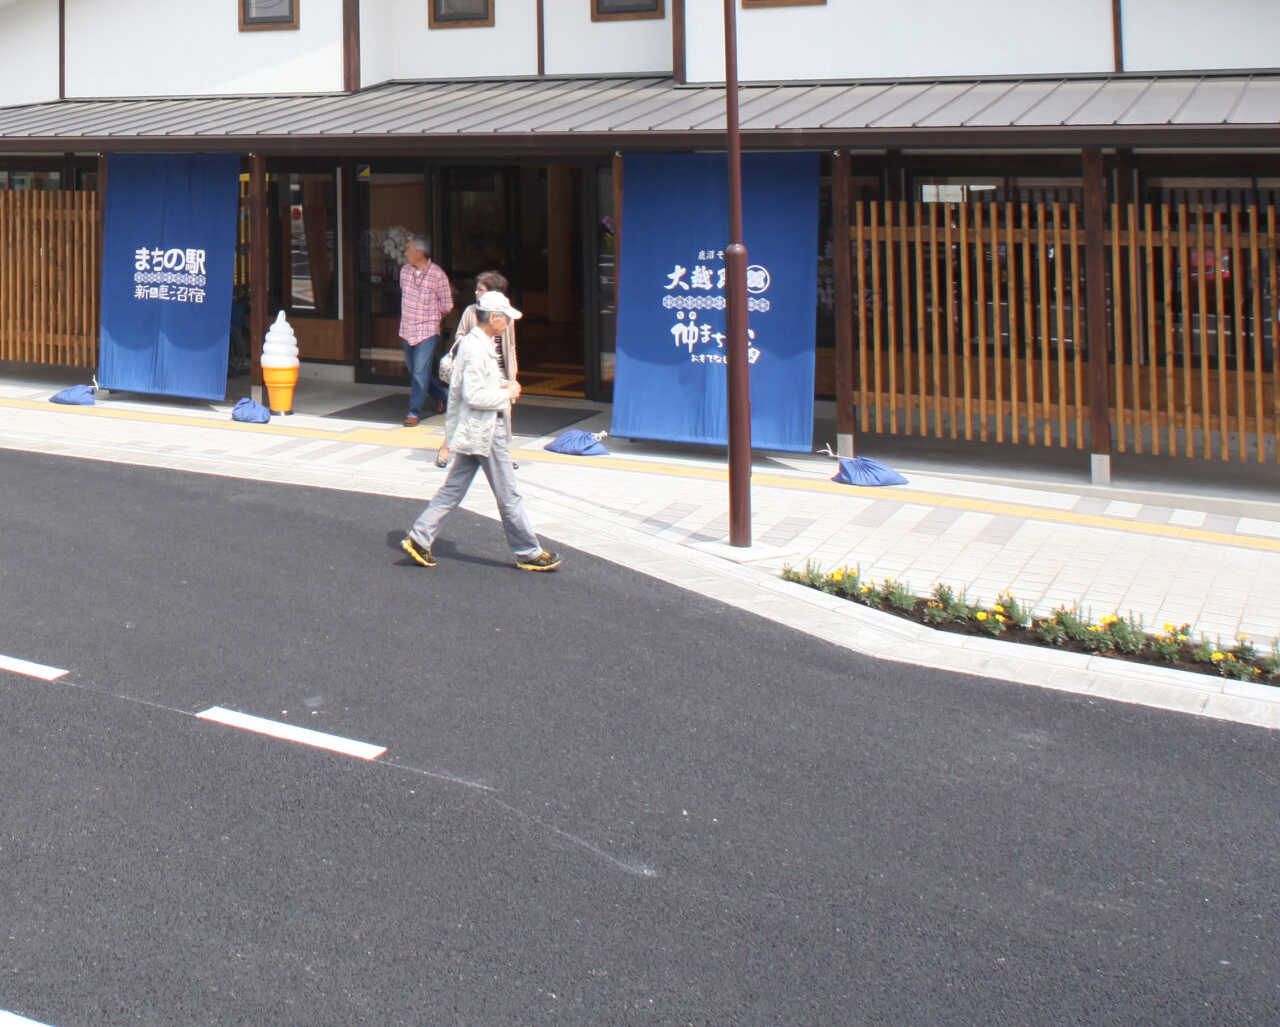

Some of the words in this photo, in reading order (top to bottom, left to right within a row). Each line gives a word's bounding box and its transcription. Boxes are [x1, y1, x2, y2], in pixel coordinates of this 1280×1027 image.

[134, 246, 207, 275] まちの駅
[133, 283, 206, 304] 新鹿沼宿
